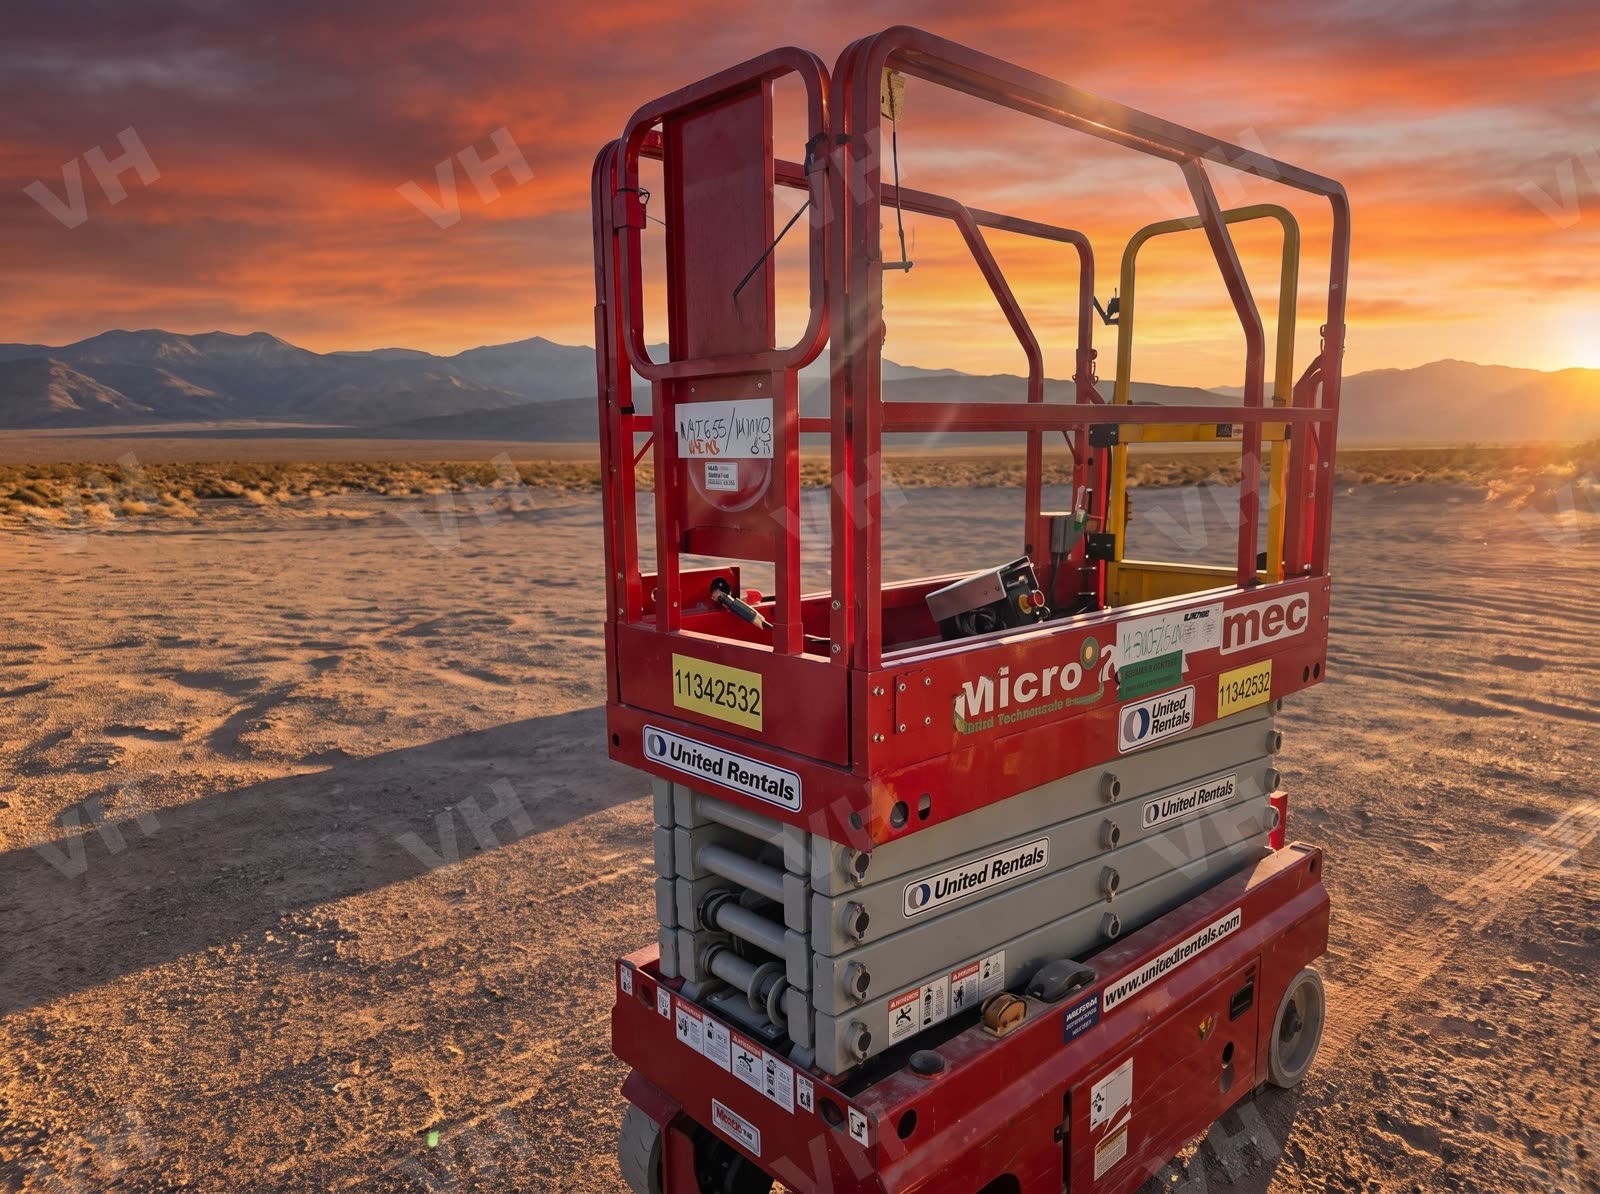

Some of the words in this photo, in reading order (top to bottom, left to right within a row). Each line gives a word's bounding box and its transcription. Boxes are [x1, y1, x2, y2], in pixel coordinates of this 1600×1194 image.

[1222, 598, 1307, 650] mec
[675, 669, 761, 716] 11342532
[955, 661, 1082, 719] Micro
[1151, 694, 1187, 719] United
[1219, 671, 1270, 707] 11342532
[1151, 710, 1191, 736] Rentals
[670, 741, 724, 777] United
[727, 762, 795, 801] Rentals
[1161, 790, 1197, 818] United
[1198, 779, 1234, 805] Rentals
[934, 863, 988, 901] United
[990, 847, 1044, 878] Rentals
